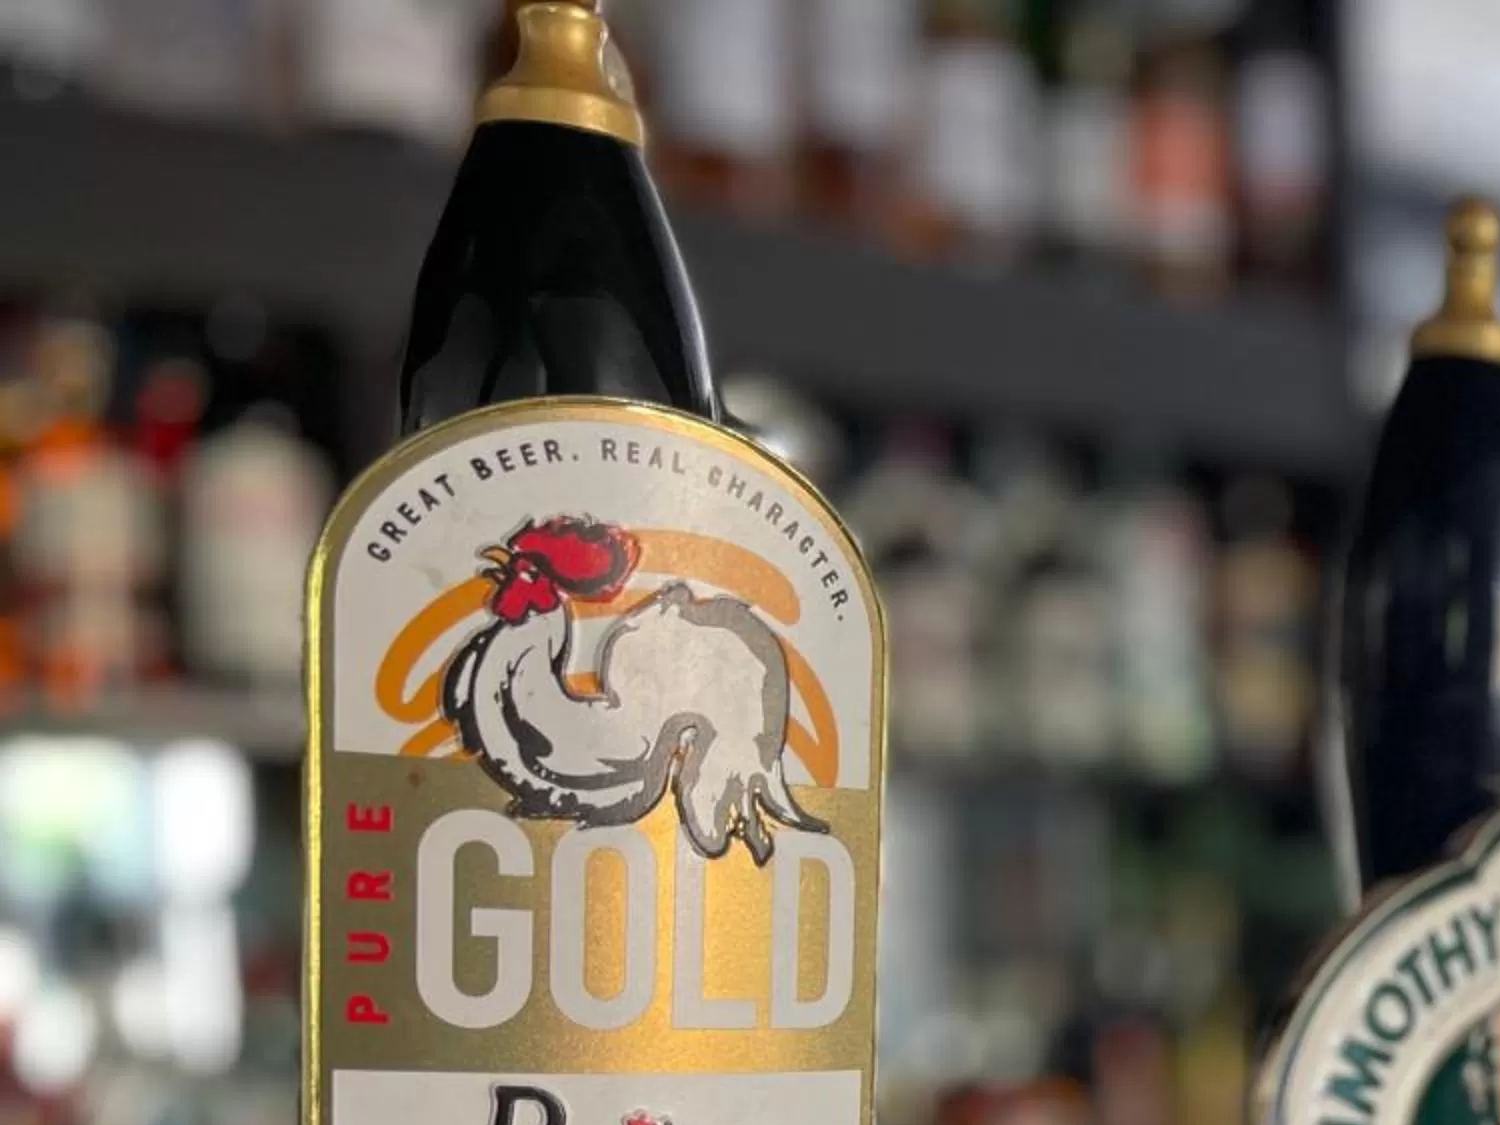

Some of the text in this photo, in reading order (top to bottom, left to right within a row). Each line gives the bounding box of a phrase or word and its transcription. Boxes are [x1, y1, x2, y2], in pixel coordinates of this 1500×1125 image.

[368, 438, 850, 622] GREAT BEER. REAL CHARACTER.
[347, 804, 392, 1024] PURE
[415, 808, 856, 1030] GOLD
